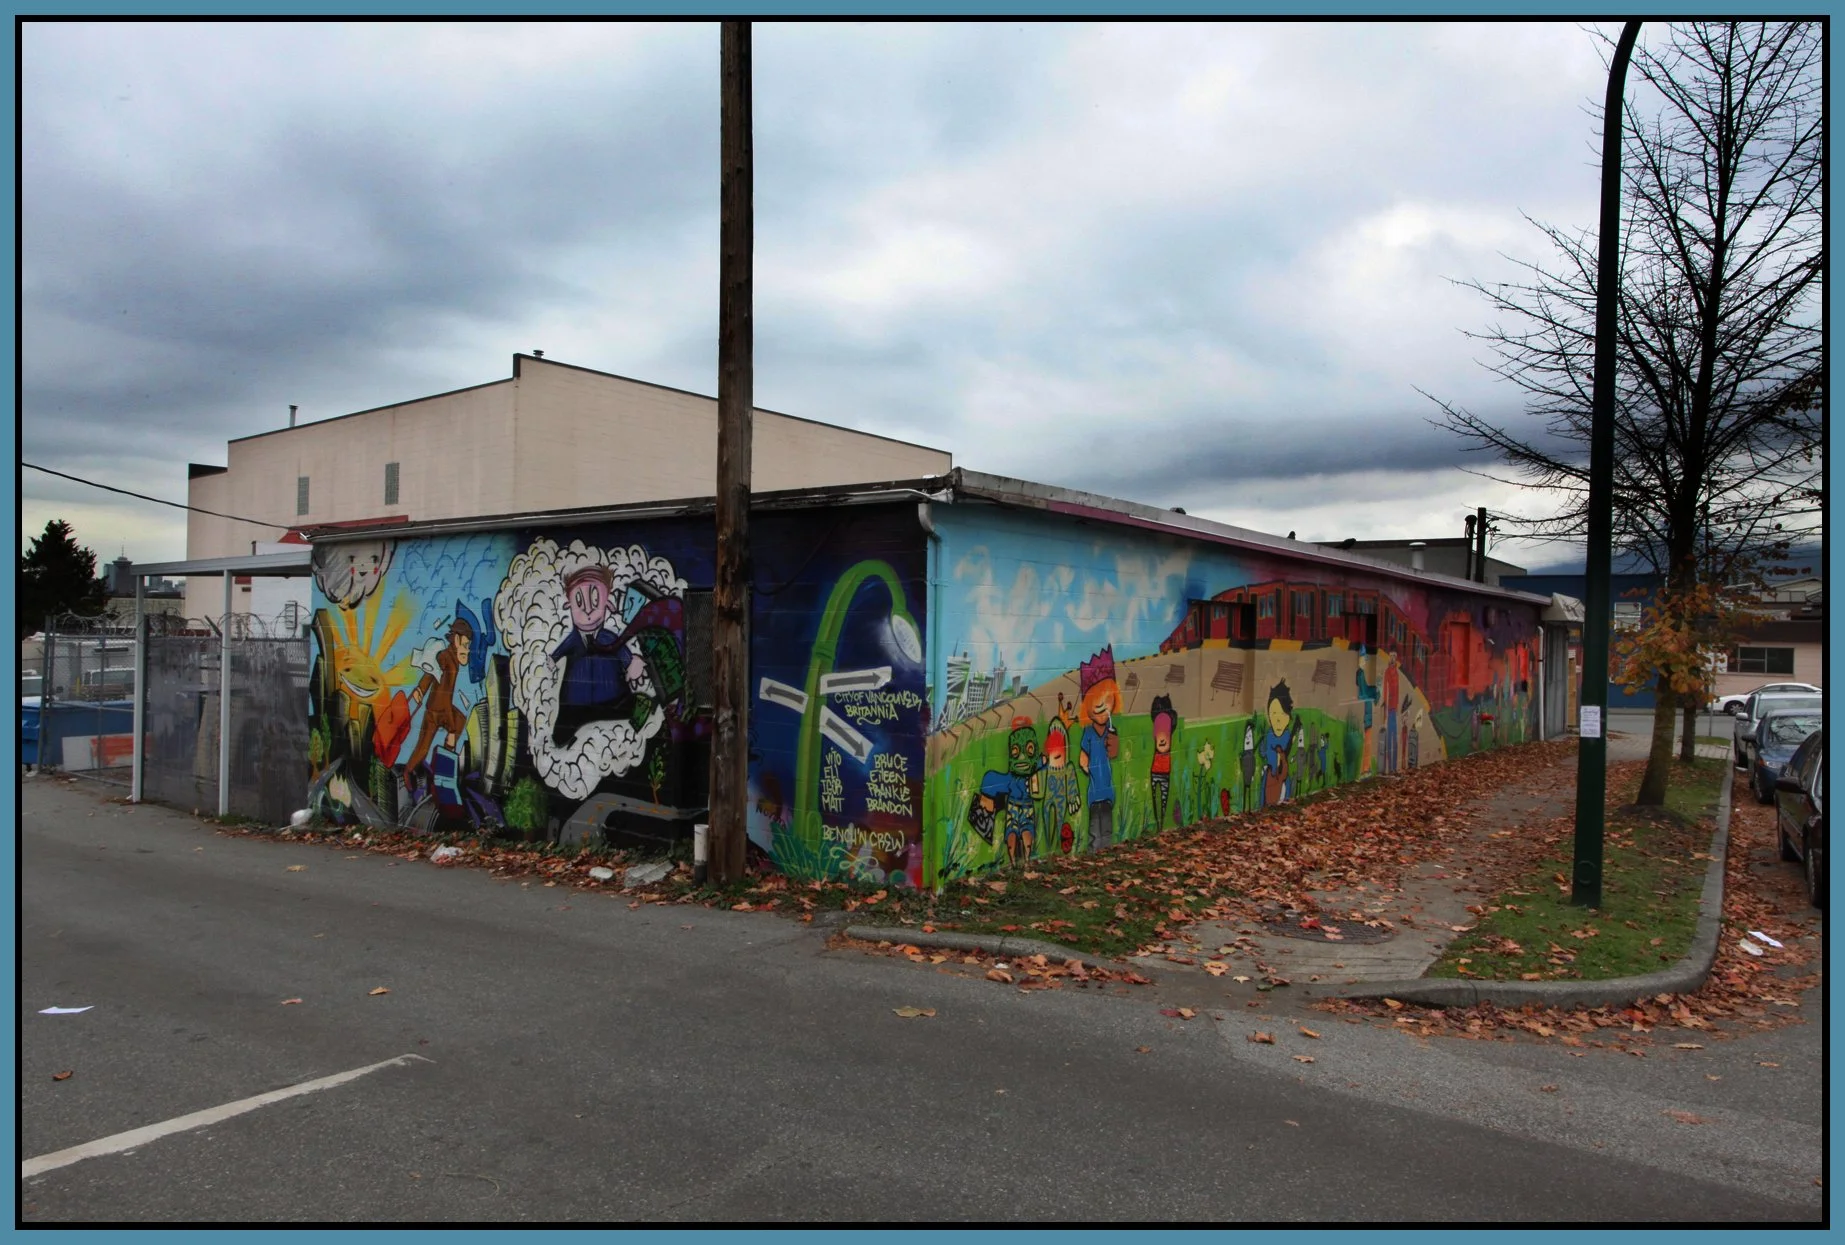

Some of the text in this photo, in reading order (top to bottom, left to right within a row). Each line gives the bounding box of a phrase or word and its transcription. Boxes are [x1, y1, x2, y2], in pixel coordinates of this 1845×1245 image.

[873, 752, 908, 772] BRUCE
[822, 795, 845, 813] MATT
[865, 797, 913, 818] BRANDON
[869, 830, 905, 852] CREW
